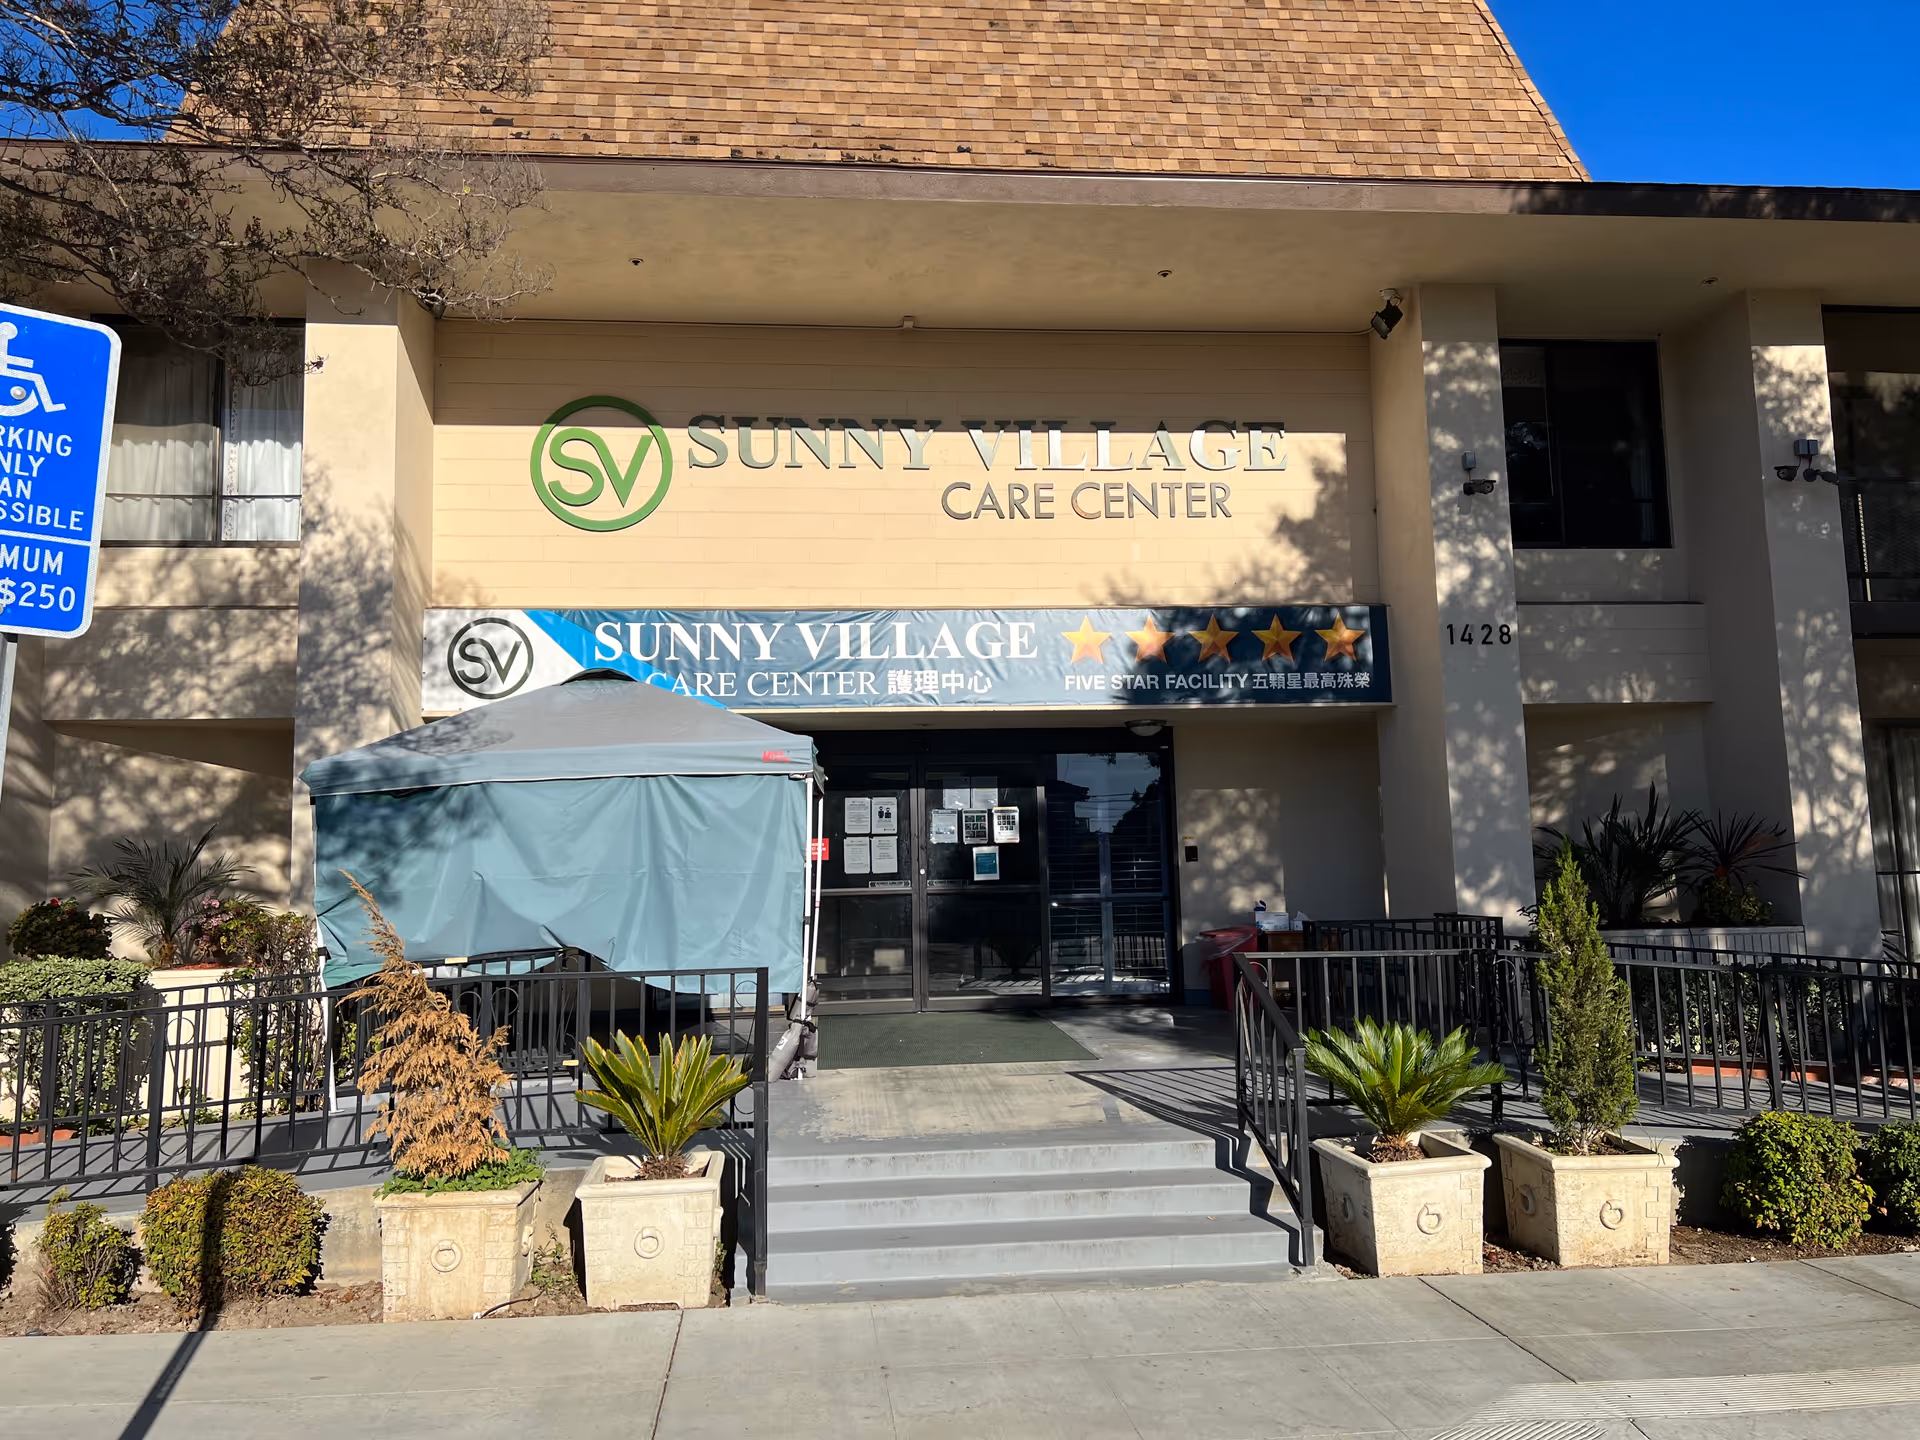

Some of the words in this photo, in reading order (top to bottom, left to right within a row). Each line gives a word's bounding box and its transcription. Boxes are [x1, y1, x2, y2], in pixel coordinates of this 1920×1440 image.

[688, 413, 941, 470] SUNNY
[961, 420, 1288, 472] VILLAGE
[941, 481, 1055, 520] CARE
[1071, 481, 1233, 520] CENTER
[0, 543, 64, 576] MUM
[0, 576, 76, 612] $250
[594, 620, 785, 662] SUNNY
[794, 621, 1039, 661] VILLAGE
[1446, 623, 1512, 645] 1428
[747, 671, 880, 697] CENTER
[887, 669, 993, 695] 護理中心
[1064, 674, 1107, 691] FIVE
[1110, 673, 1160, 690] STAR
[1164, 673, 1249, 690] FACILITY
[1252, 671, 1371, 690] 五顆星最高殊榮
